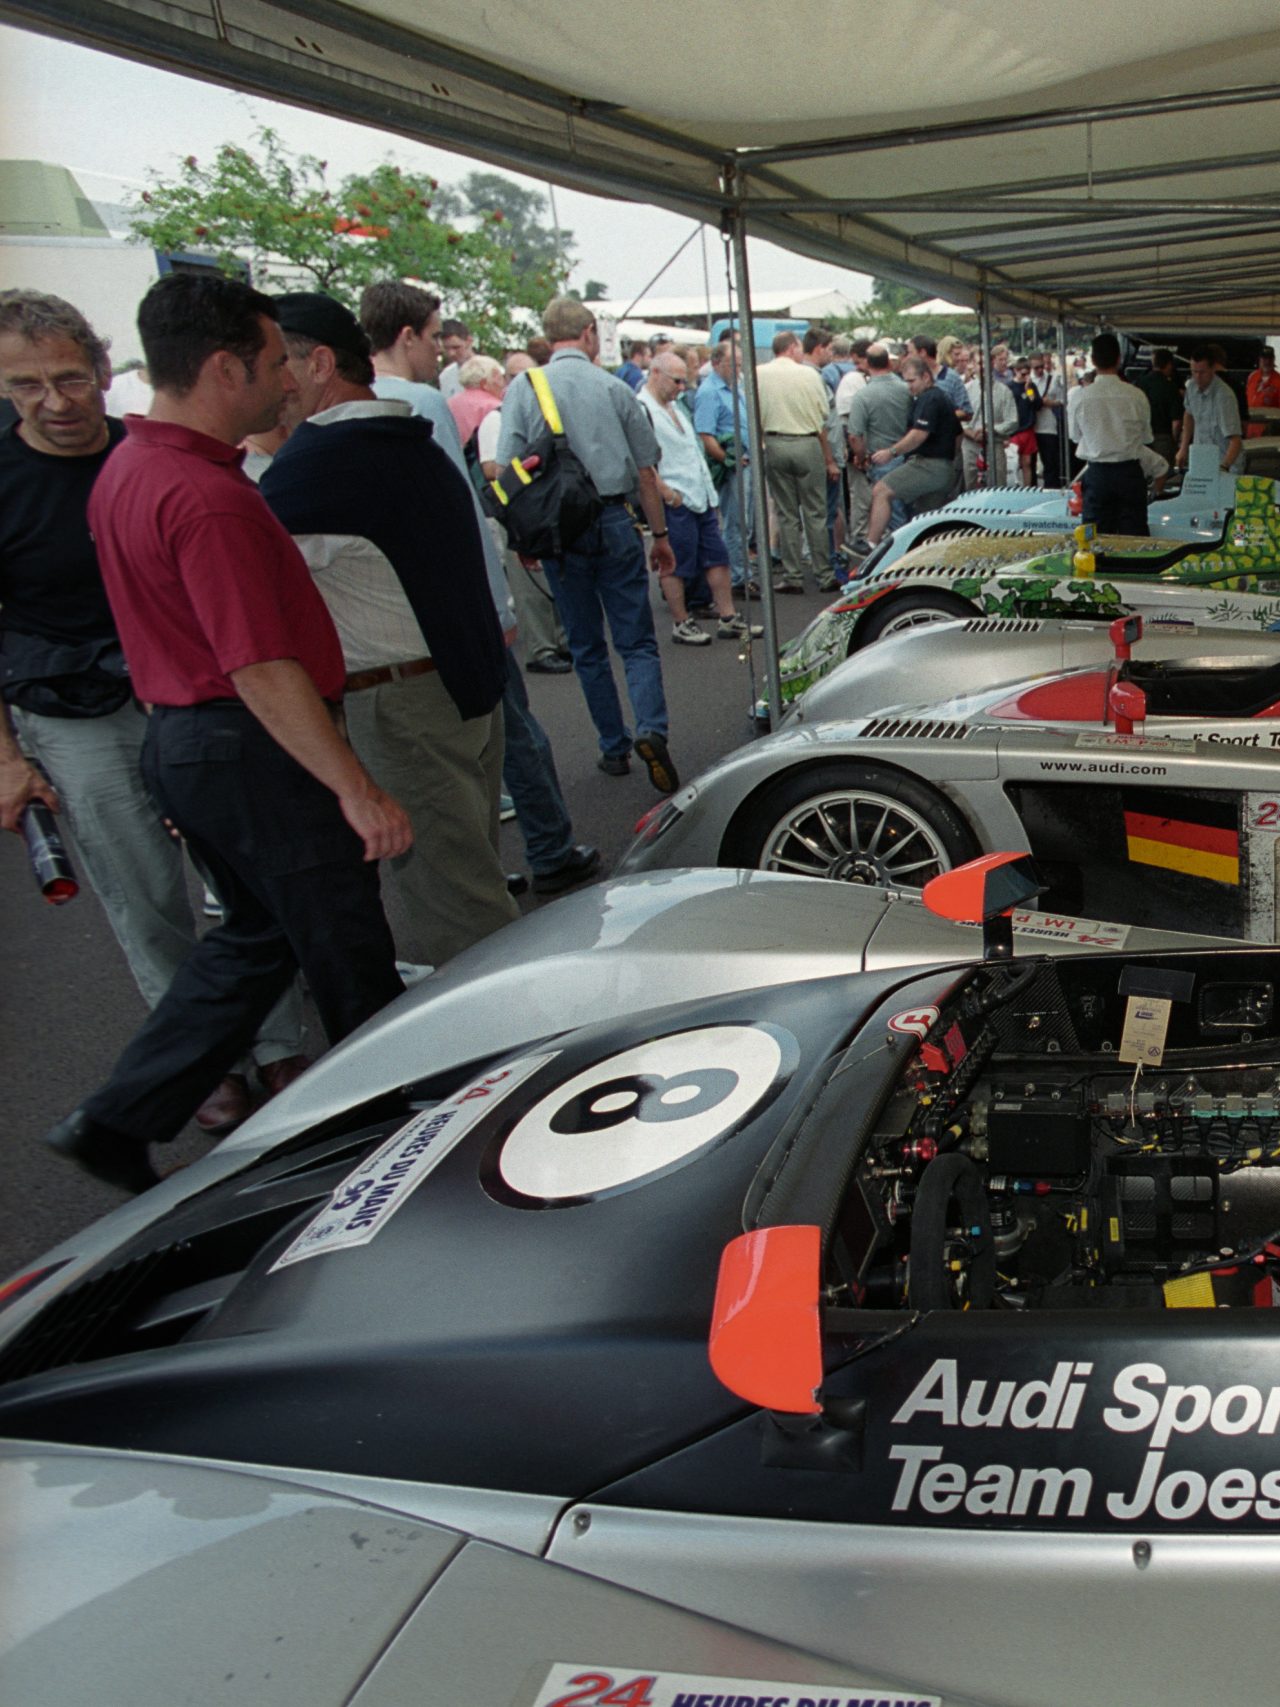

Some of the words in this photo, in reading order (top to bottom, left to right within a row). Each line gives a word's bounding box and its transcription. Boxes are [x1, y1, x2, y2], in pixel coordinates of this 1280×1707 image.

[1040, 762, 1167, 775] www.audi.com
[549, 1067, 740, 1135] 8
[399, 1109, 459, 1160] HEURES
[382, 1158, 417, 1181] DU
[345, 1181, 401, 1231] MANS
[889, 1358, 1094, 1430] Audi
[888, 1444, 1094, 1518] Team
[546, 1672, 658, 1707] 24
